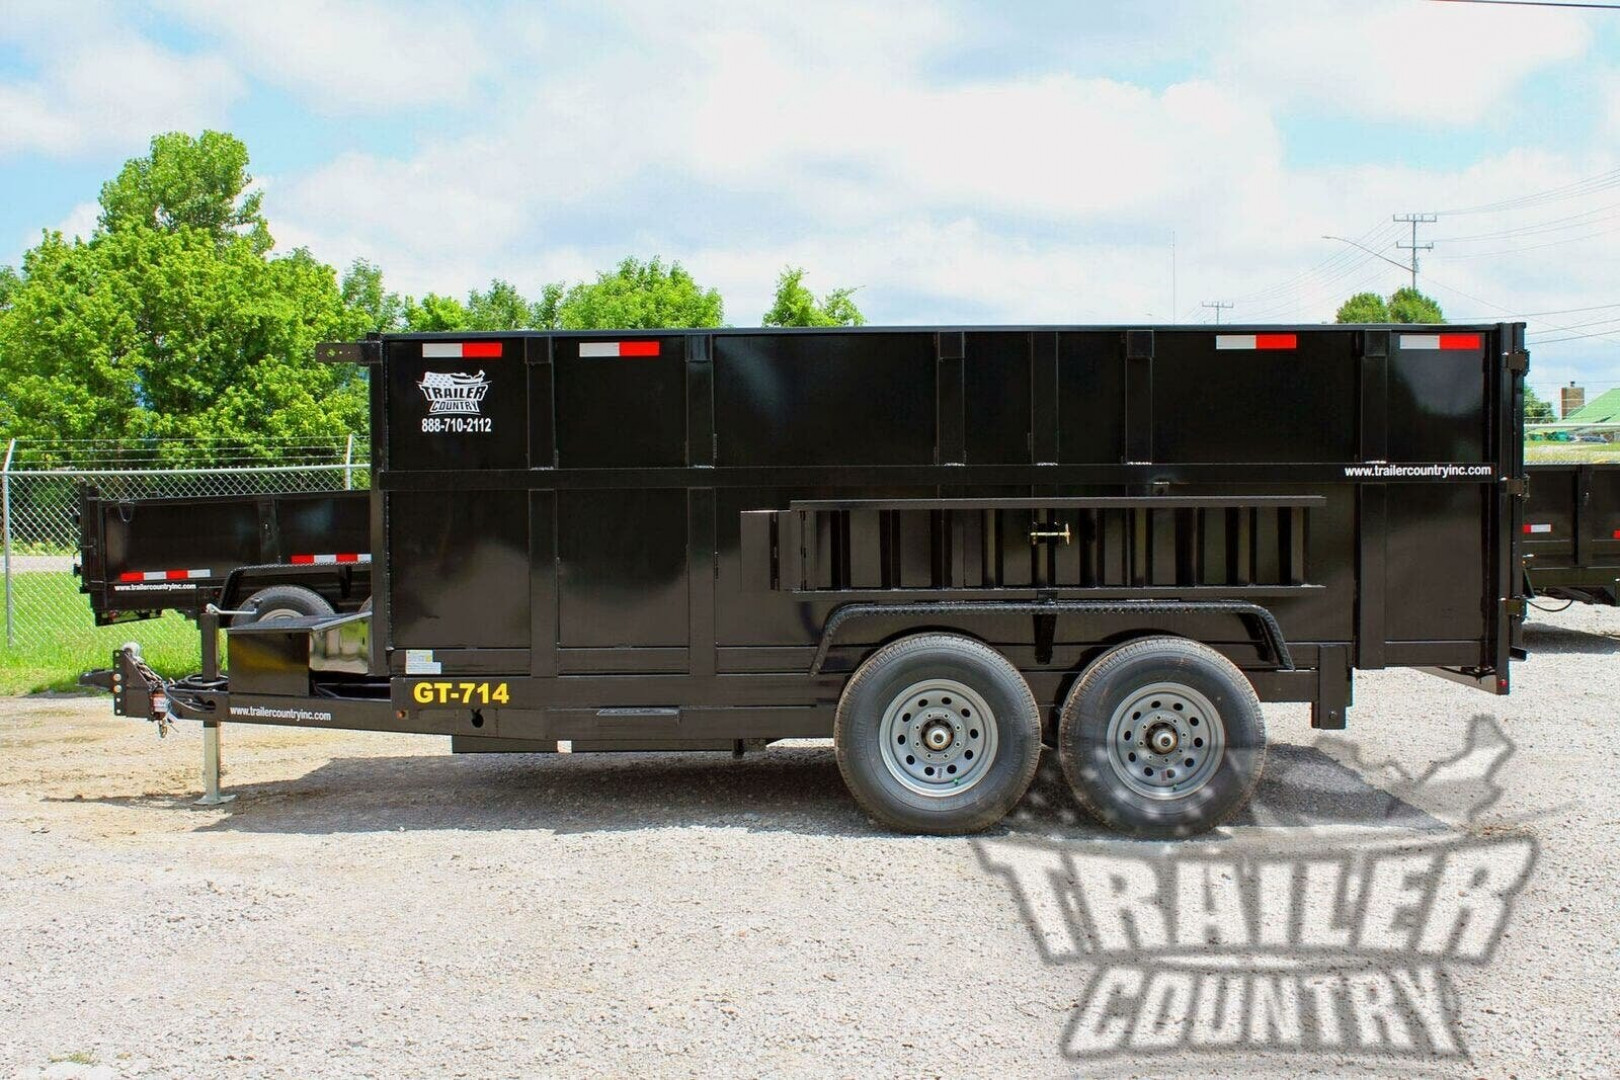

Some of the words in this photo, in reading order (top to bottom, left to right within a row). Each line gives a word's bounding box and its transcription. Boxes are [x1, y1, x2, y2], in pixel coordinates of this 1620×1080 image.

[420, 385, 487, 400] TRAILER
[430, 401, 479, 413] COUNTRY
[421, 418, 491, 432] 888-710-2112
[1344, 464, 1492, 478] www.trailercountryinc.com
[114, 582, 197, 591] www.trailercountryinc.com
[413, 682, 510, 704] GT-714
[229, 705, 332, 722] www.trailercountryinc.com
